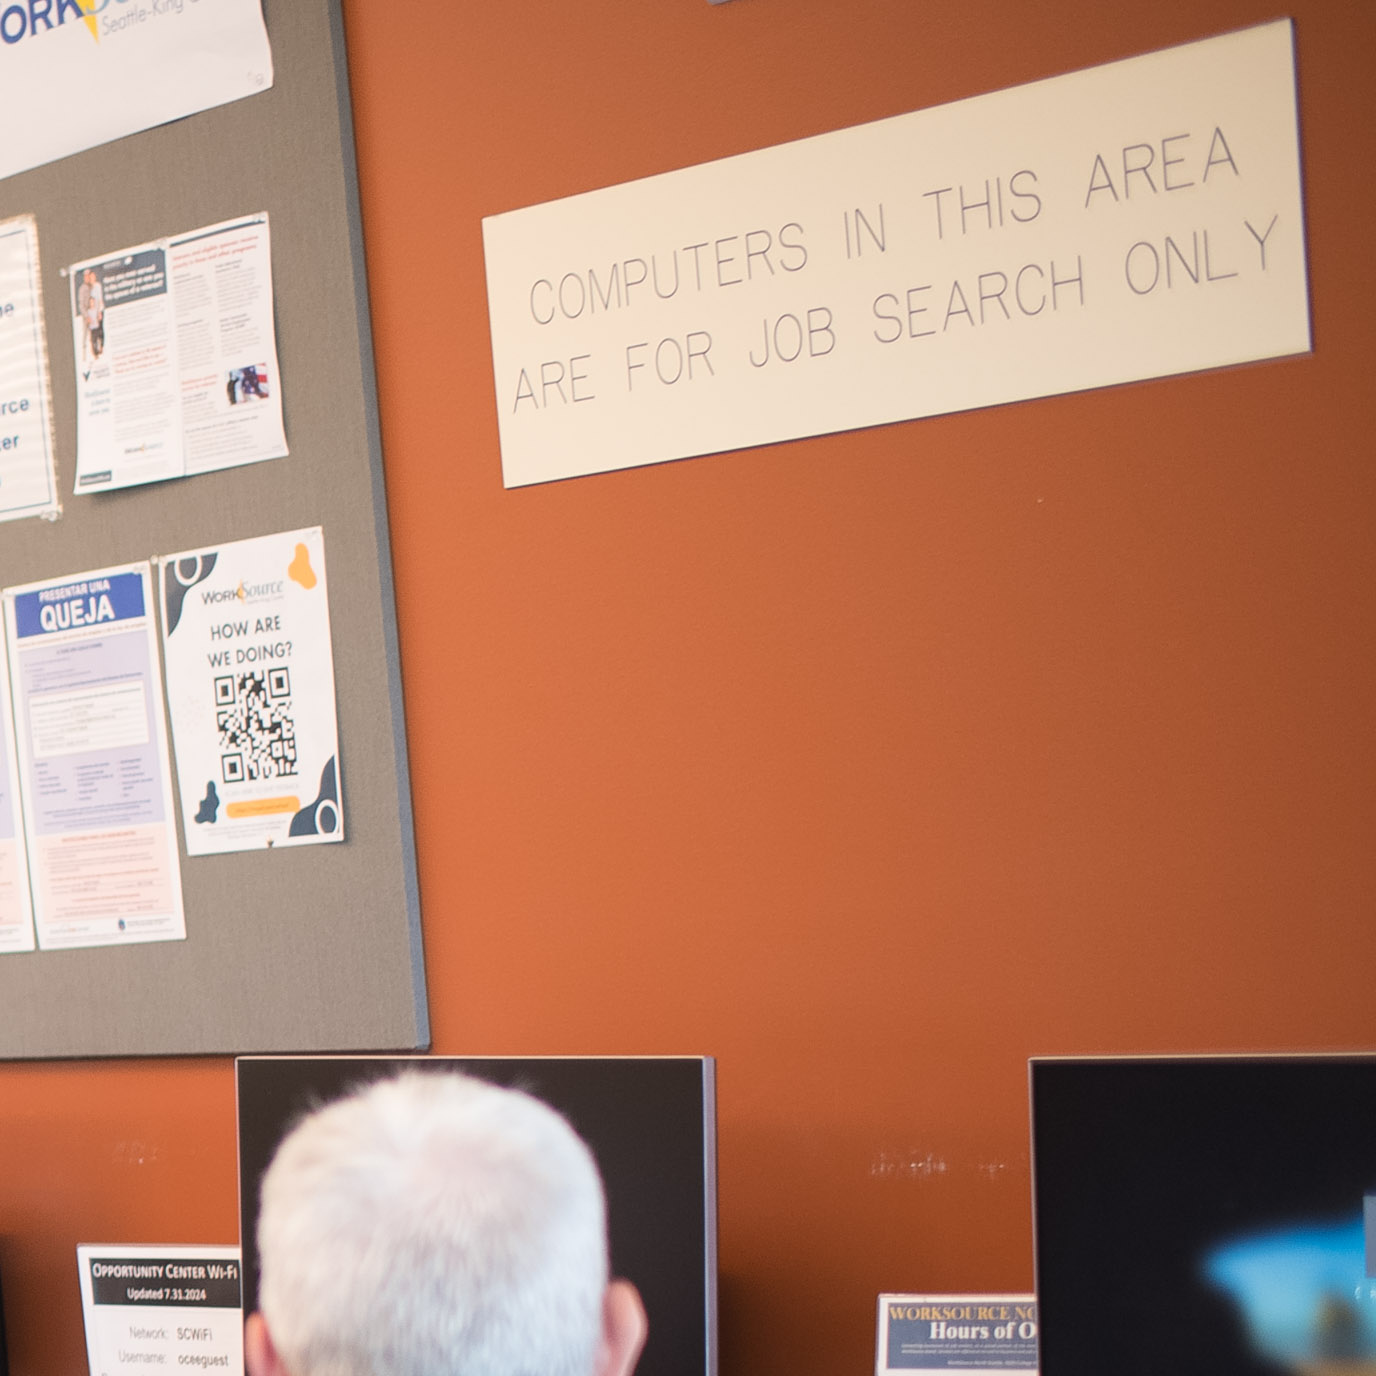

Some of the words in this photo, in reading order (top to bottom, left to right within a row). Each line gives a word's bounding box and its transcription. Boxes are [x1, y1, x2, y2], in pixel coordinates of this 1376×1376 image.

[528, 222, 809, 327] COMPUTERS
[844, 204, 889, 260] IN
[923, 169, 1044, 241] THIS
[1083, 126, 1240, 208] AREA
[511, 354, 597, 415] ARE
[625, 330, 715, 393] FOR
[749, 305, 837, 372] JOB
[872, 256, 1087, 344] SEARCH
[1124, 214, 1281, 297] ONLY
[38, 583, 89, 603] PRESENTAR
[88, 578, 111, 594] UNA
[40, 594, 116, 633] QUEJA
[210, 619, 249, 641] HOW
[254, 615, 282, 635] ARE
[207, 651, 231, 668] WE
[236, 641, 293, 665] DOING?
[126, 1287, 163, 1301] Updated
[164, 1288, 207, 1301] 7.31.2024
[889, 1306, 1010, 1321] WORKSOURCE
[129, 1326, 169, 1340] Network:
[929, 1321, 990, 1340] Hours
[993, 1321, 1016, 1340] of
[118, 1350, 167, 1364] Username:
